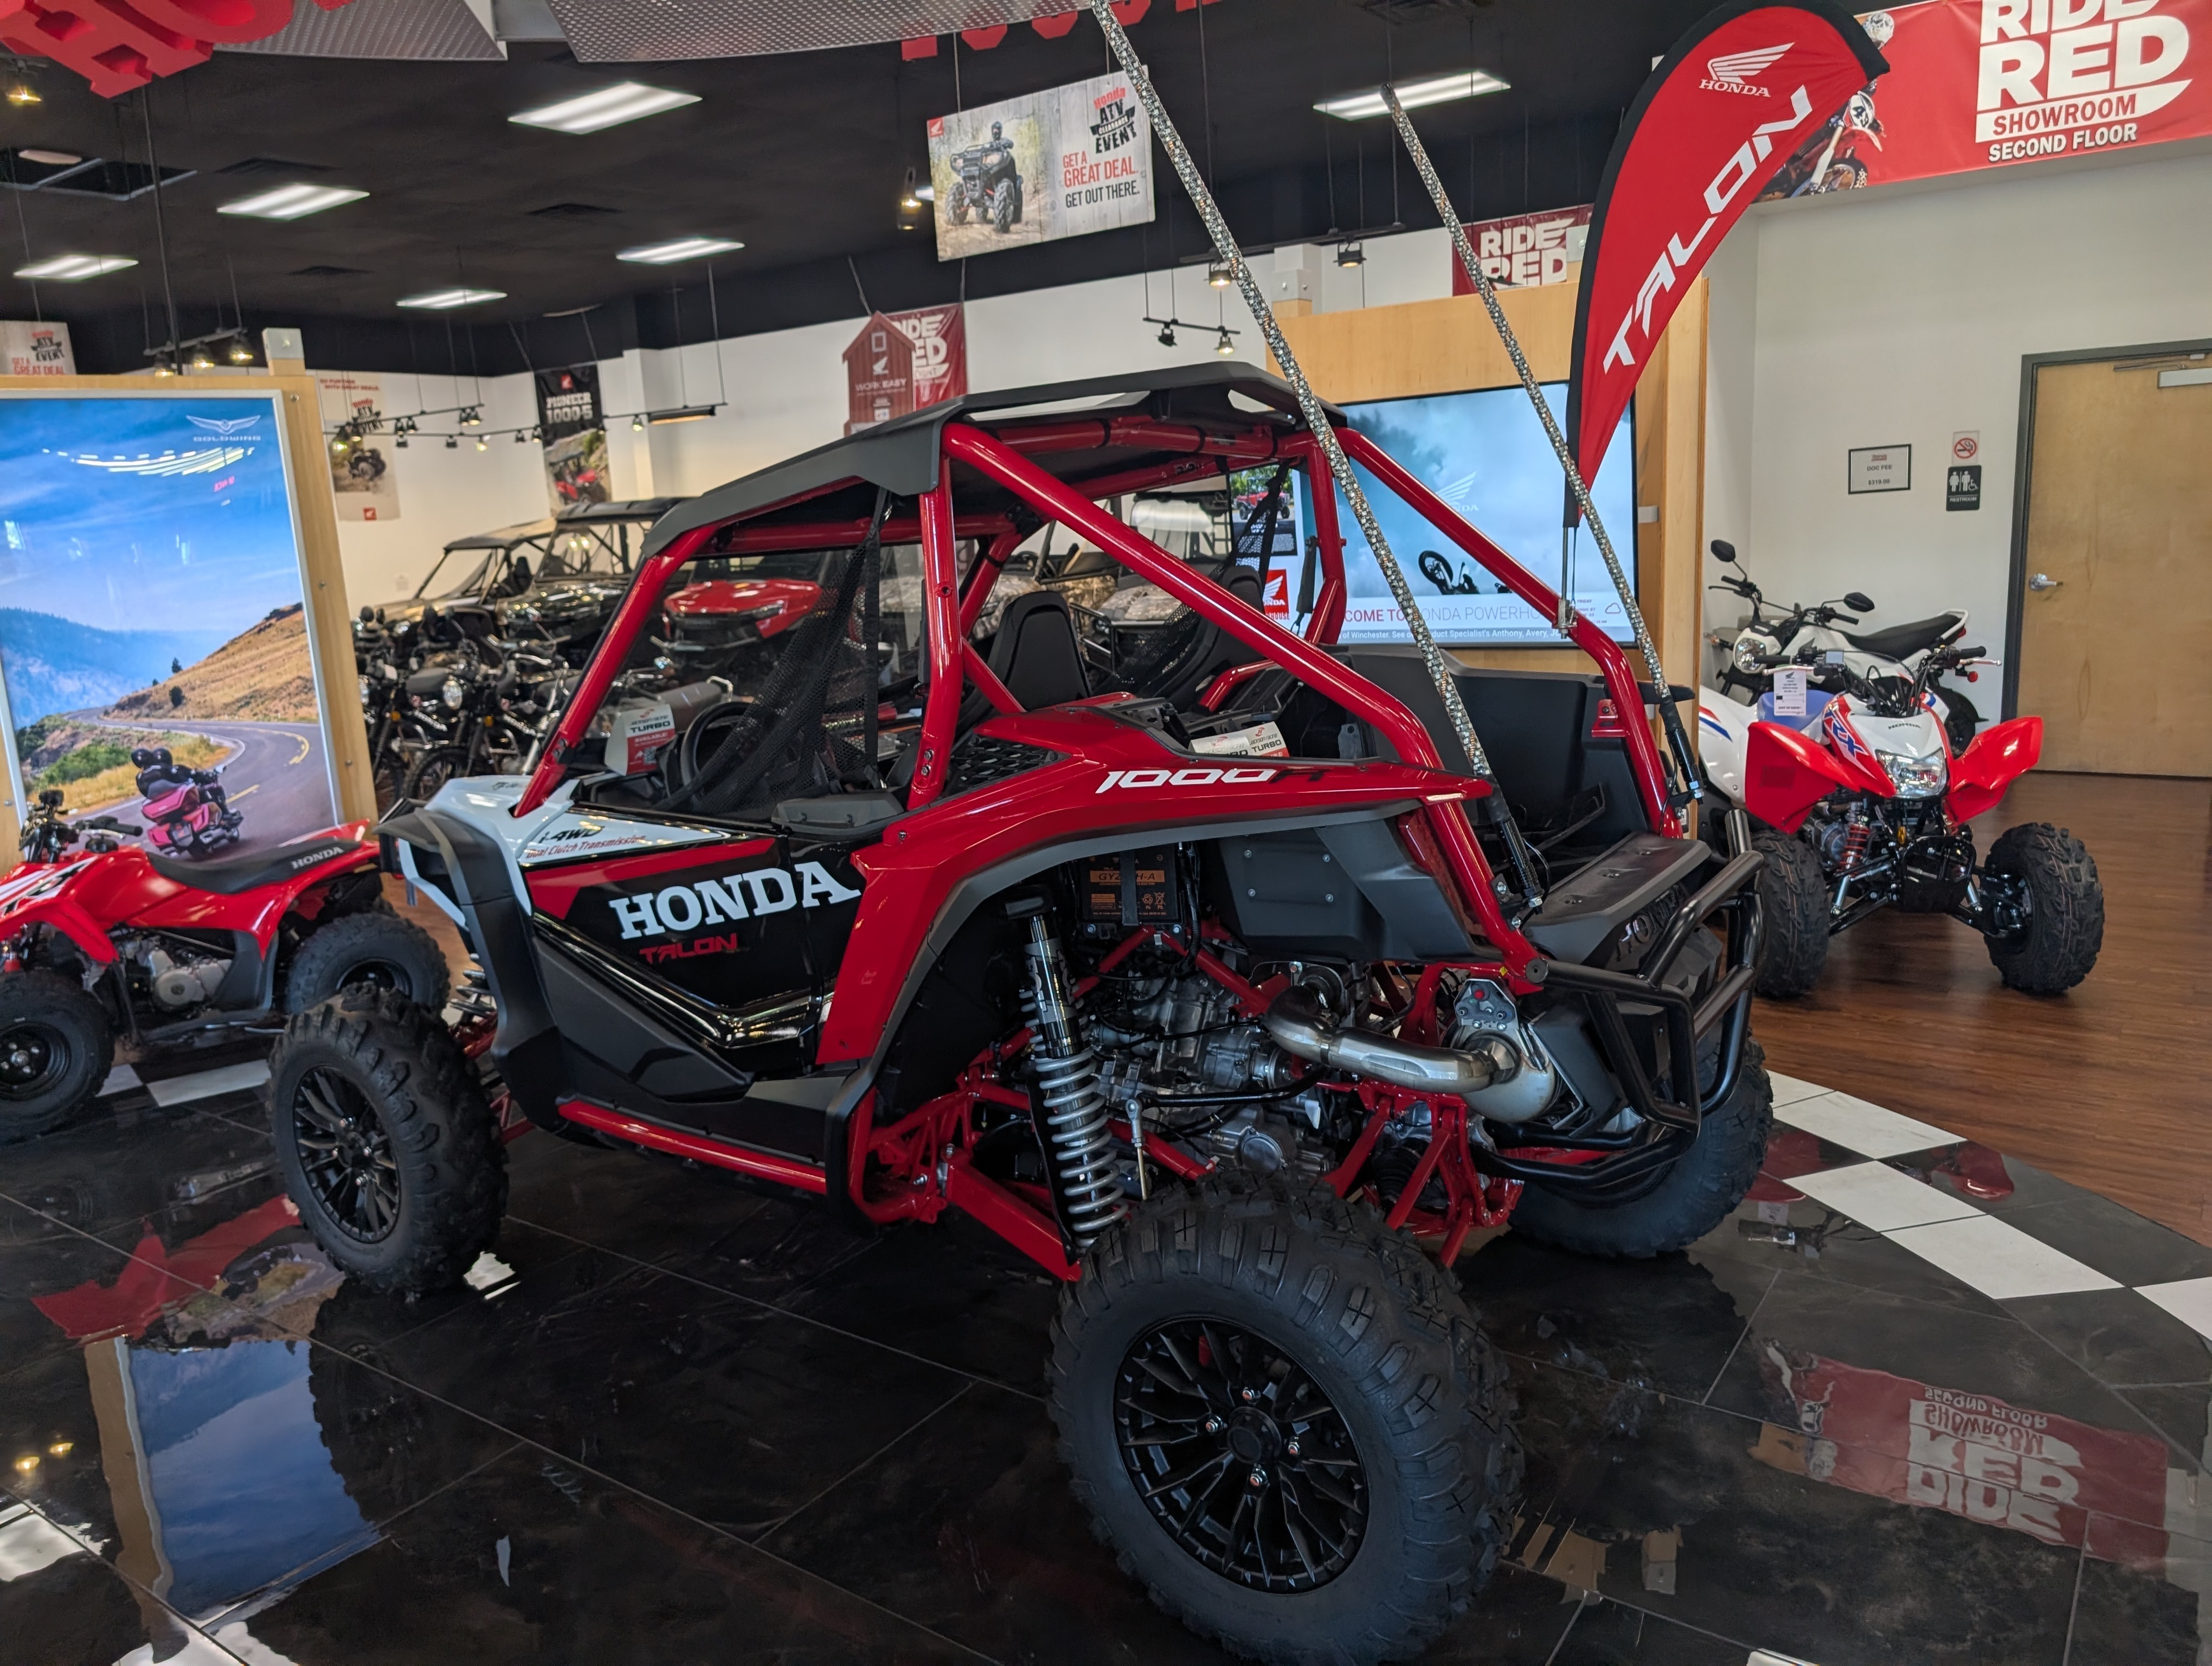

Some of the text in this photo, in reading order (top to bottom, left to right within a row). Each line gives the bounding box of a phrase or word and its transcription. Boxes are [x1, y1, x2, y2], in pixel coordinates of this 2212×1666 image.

[1977, 15, 2189, 112] RED
[1699, 79, 1771, 98] HONDA
[1098, 114, 1129, 135] CLEARANCE
[1100, 99, 1124, 124] ATV
[1993, 94, 2137, 136] SHOWROOM
[1095, 121, 1137, 154] EVENT
[1988, 123, 2138, 162] SECOND FLOOR
[1063, 151, 1087, 169] GET A
[1064, 156, 1139, 188] GREAT DEAL.
[1065, 180, 1140, 208] GET OUT THERE.
[1481, 218, 1575, 258] RIDE
[1603, 84, 1813, 374] TALON
[1480, 247, 1567, 287] RED
[895, 314, 945, 340] IDE
[915, 336, 948, 367] ED
[546, 392, 592, 409] PIONEER
[1455, 504, 1480, 512] NDA
[1346, 609, 1384, 623] COME
[1421, 607, 1461, 621] ONDA
[1351, 631, 1390, 639] Winchester.
[1432, 630, 1448, 638] duct
[1491, 629, 1524, 639] Anthony,
[1525, 629, 1548, 638] Avery,
[630, 720, 671, 733] TURBO
[1251, 739, 1282, 753] TURBO
[291, 847, 344, 869] HONDA
[548, 843, 577, 855] Clutch
[579, 835, 646, 851] Transmission
[608, 861, 862, 940] HONDA
[639, 933, 737, 964] TALON
